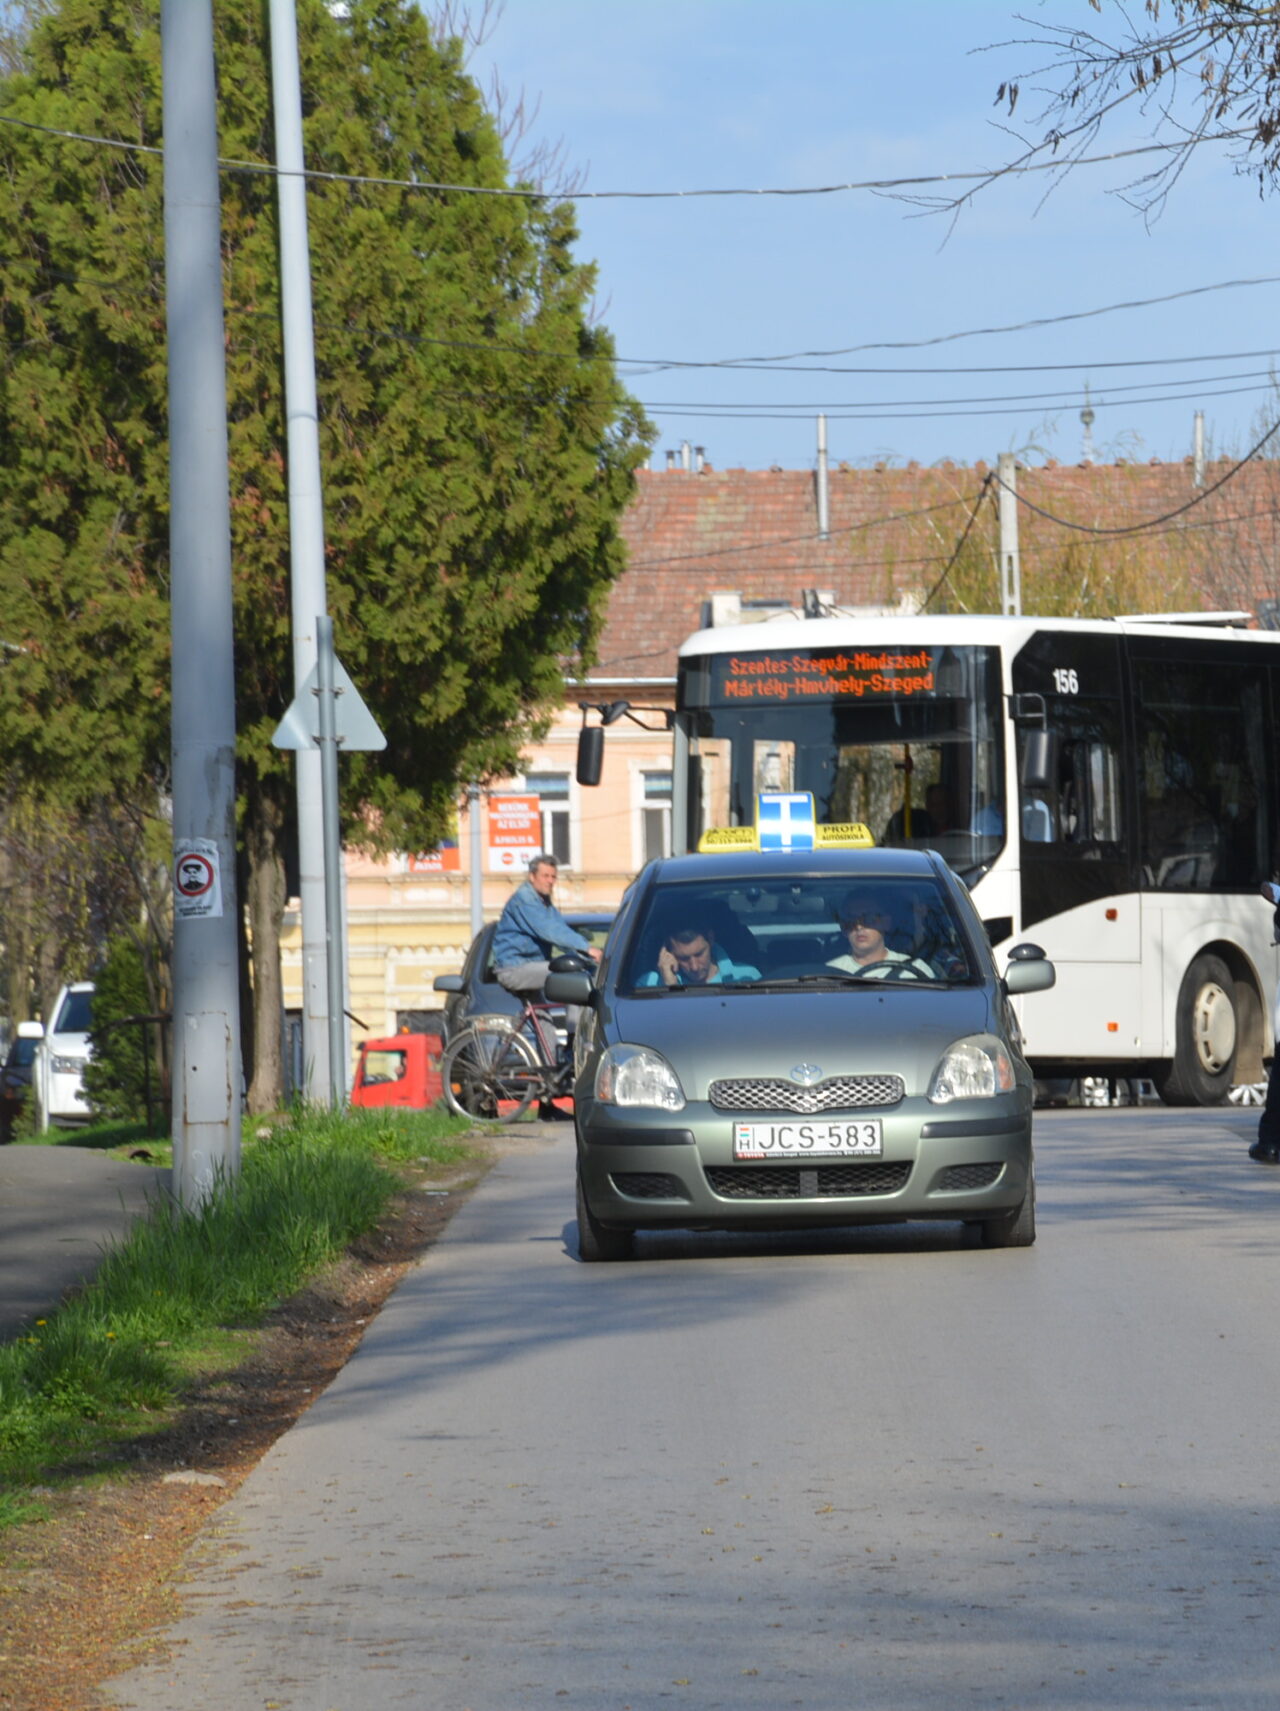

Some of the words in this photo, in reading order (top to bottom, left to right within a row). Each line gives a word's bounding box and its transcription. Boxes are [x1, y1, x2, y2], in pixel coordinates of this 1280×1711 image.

[729, 651, 933, 675] Szentes-Szegvár-Mindszent-
[725, 673, 934, 699] Mártély-Hmvhely-Szeged
[1052, 668, 1079, 695] 156
[823, 824, 863, 834] PROFI
[739, 1139, 750, 1150] H
[758, 1124, 877, 1150] JCS-583
